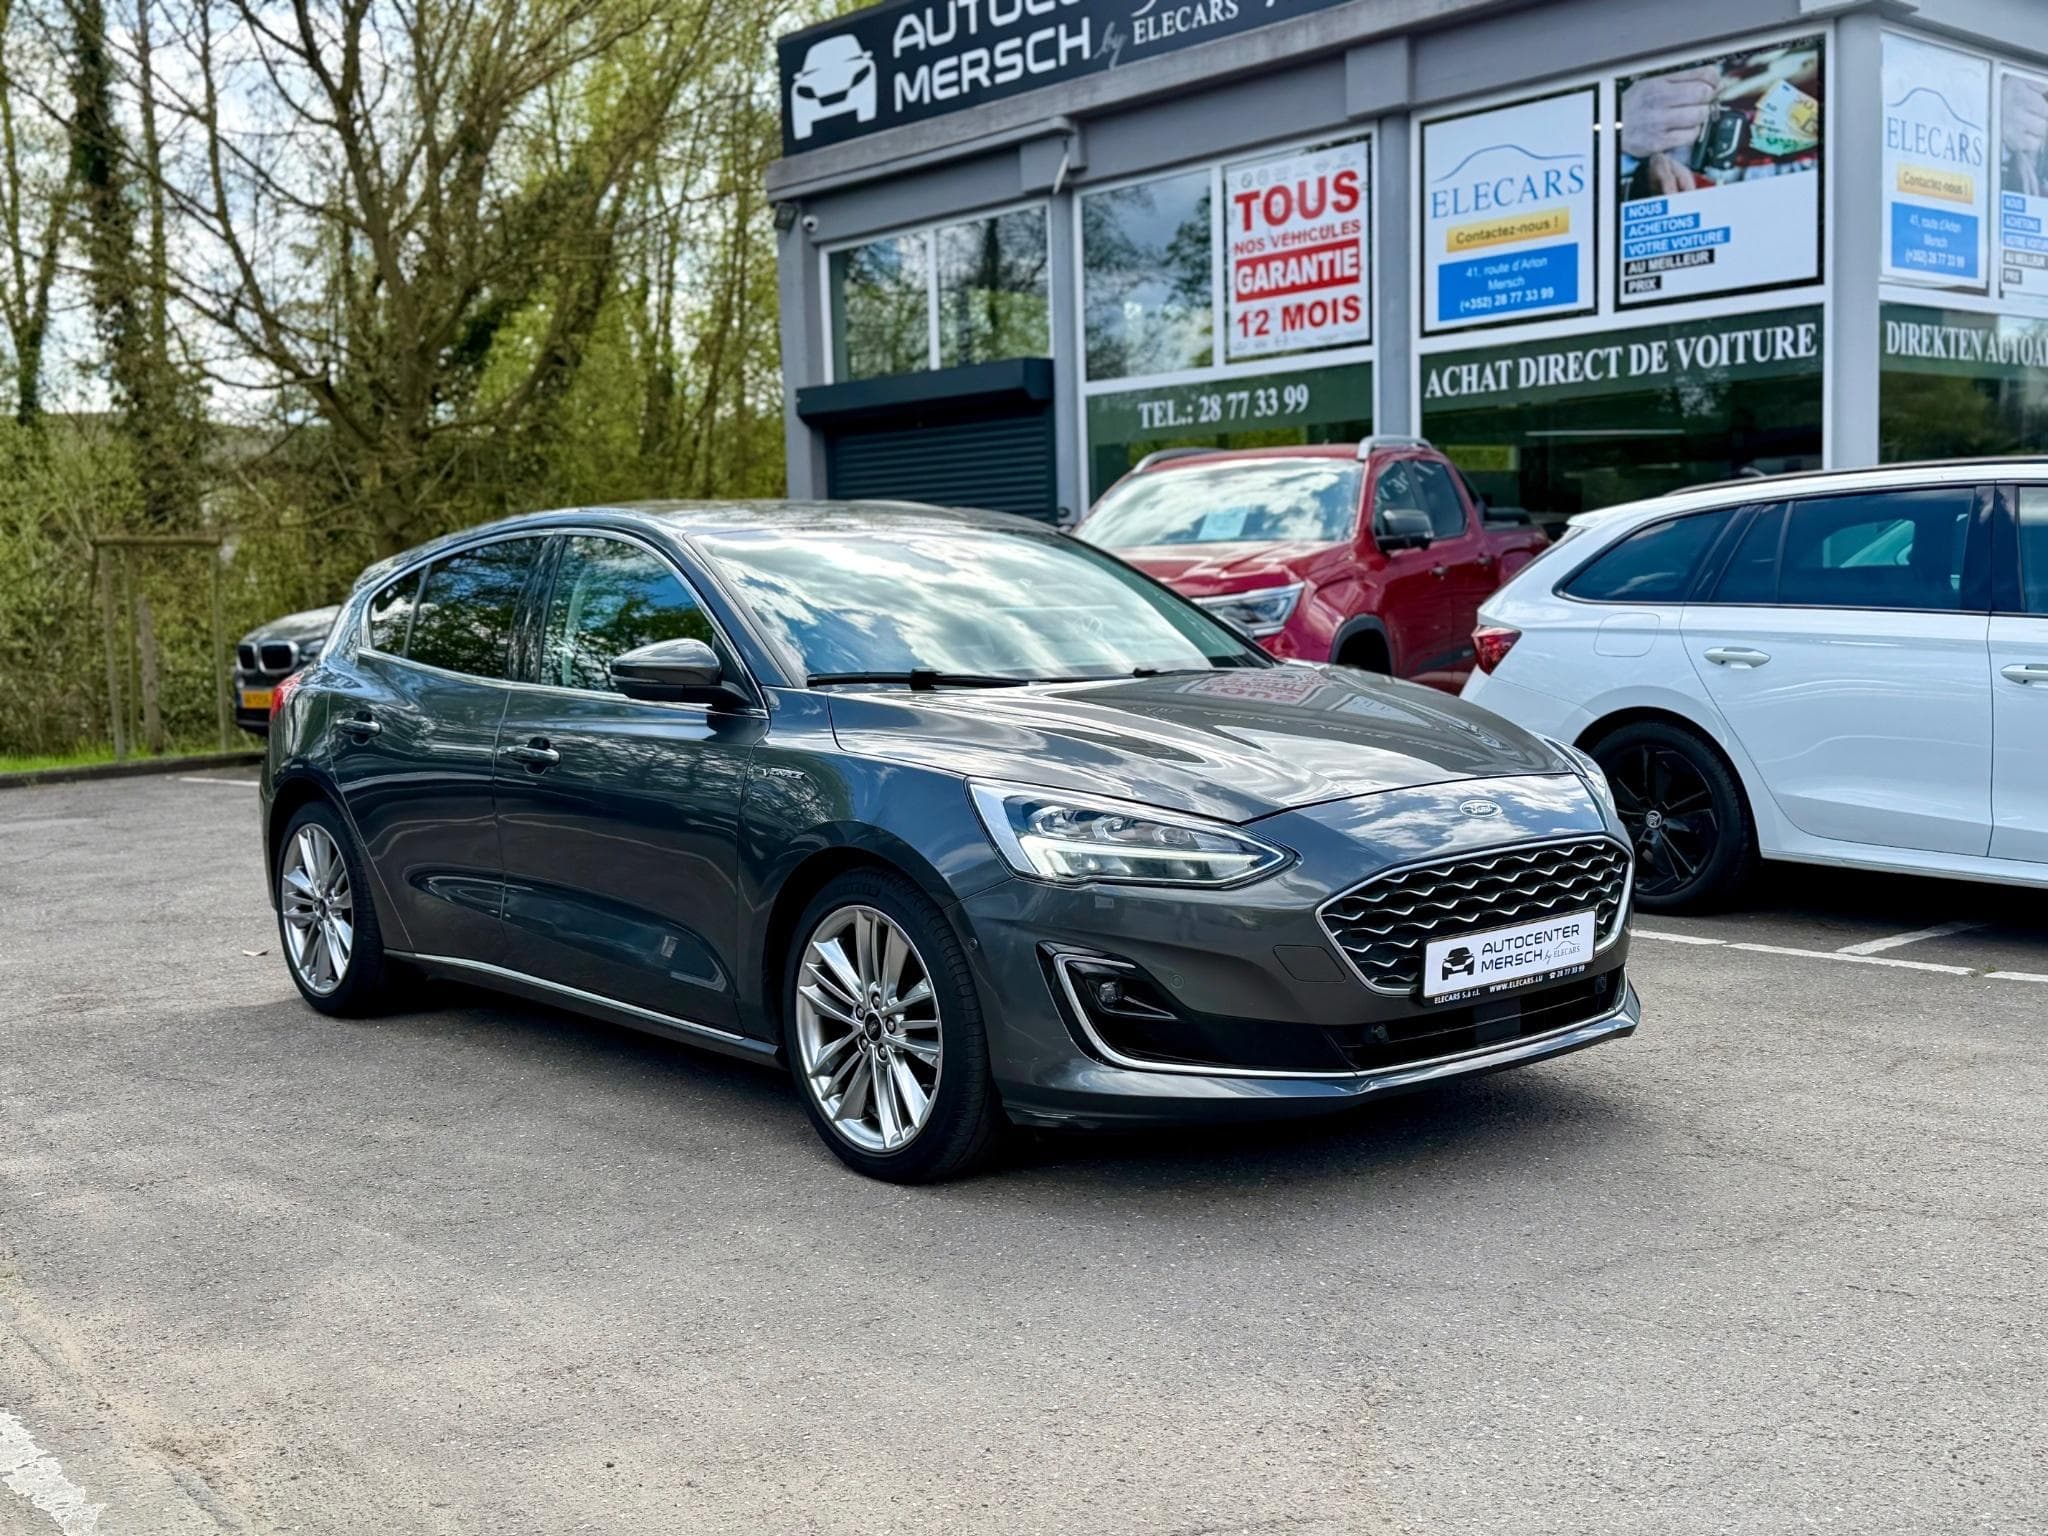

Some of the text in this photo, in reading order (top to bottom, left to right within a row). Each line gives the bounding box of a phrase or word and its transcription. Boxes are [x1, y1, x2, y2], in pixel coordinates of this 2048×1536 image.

[893, 0, 1081, 58] AUTO
[894, 16, 1090, 112] MERSCH
[1133, 0, 1239, 45] ELECARS
[1886, 116, 1983, 167] ELECARS
[1234, 169, 1360, 232] TOUS
[1431, 164, 1585, 219] ELECARS
[1628, 202, 1663, 219] NOUS
[1234, 219, 1361, 255] NOS VEHICULES
[1455, 219, 1550, 244] Contactez-nous
[1628, 216, 1695, 238] ACHETONS
[1628, 230, 1725, 256] VOTRE VOITURE
[1236, 245, 1359, 295] GARANTIE
[1487, 276, 1526, 290] Mersch
[1237, 294, 1360, 338] 12 MOIS
[1424, 323, 1818, 398] ACHAT DIRECT DE VOITURE
[1886, 320, 2048, 367] DIREKTEN AUTOA
[1138, 384, 1309, 428] TEL.: 28 77 33 99
[1481, 949, 1542, 972] MERSCH
[1553, 946, 1580, 958] ELECARS
[1482, 924, 1580, 955] AUTOCENTER
[1434, 992, 1460, 1004] ELECARS
[1489, 975, 1543, 993] WWW.ELECARS.LU
